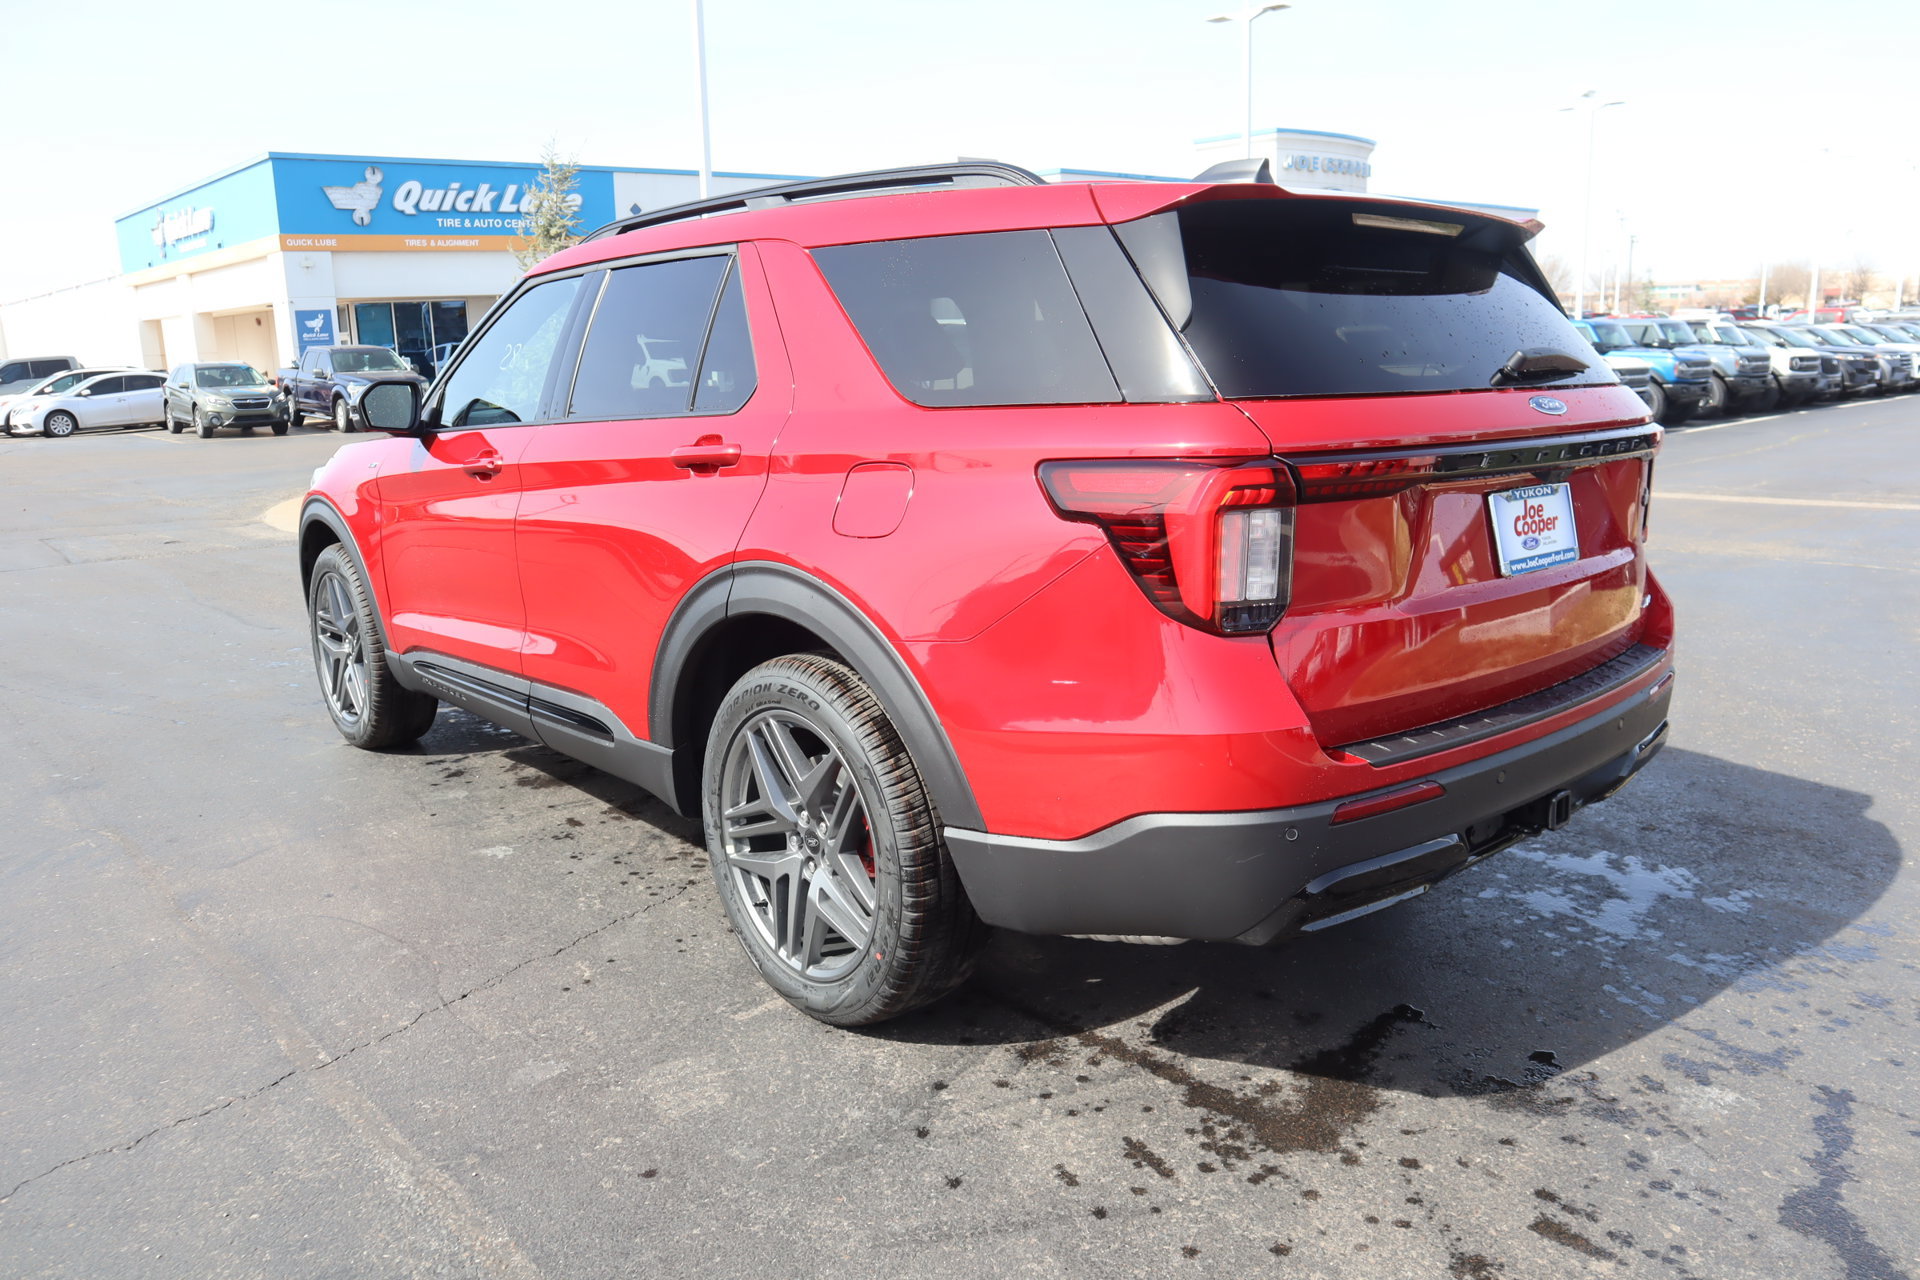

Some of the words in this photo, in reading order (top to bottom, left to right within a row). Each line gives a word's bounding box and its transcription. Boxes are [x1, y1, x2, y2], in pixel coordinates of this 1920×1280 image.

[1282, 154, 1321, 172] JOE
[393, 180, 498, 215] Quick
[436, 218, 462, 228] TIRE
[464, 218, 472, 228] &
[473, 218, 502, 228] AUTO
[286, 238, 313, 247] QUICK
[315, 238, 337, 247] LUBE
[404, 238, 428, 247] TIRES
[437, 239, 480, 248] ALIGNMENT
[1514, 486, 1552, 499] YUKON
[1521, 499, 1544, 521] Joe
[1513, 514, 1559, 537] Cooper
[776, 683, 821, 711] ZERO
